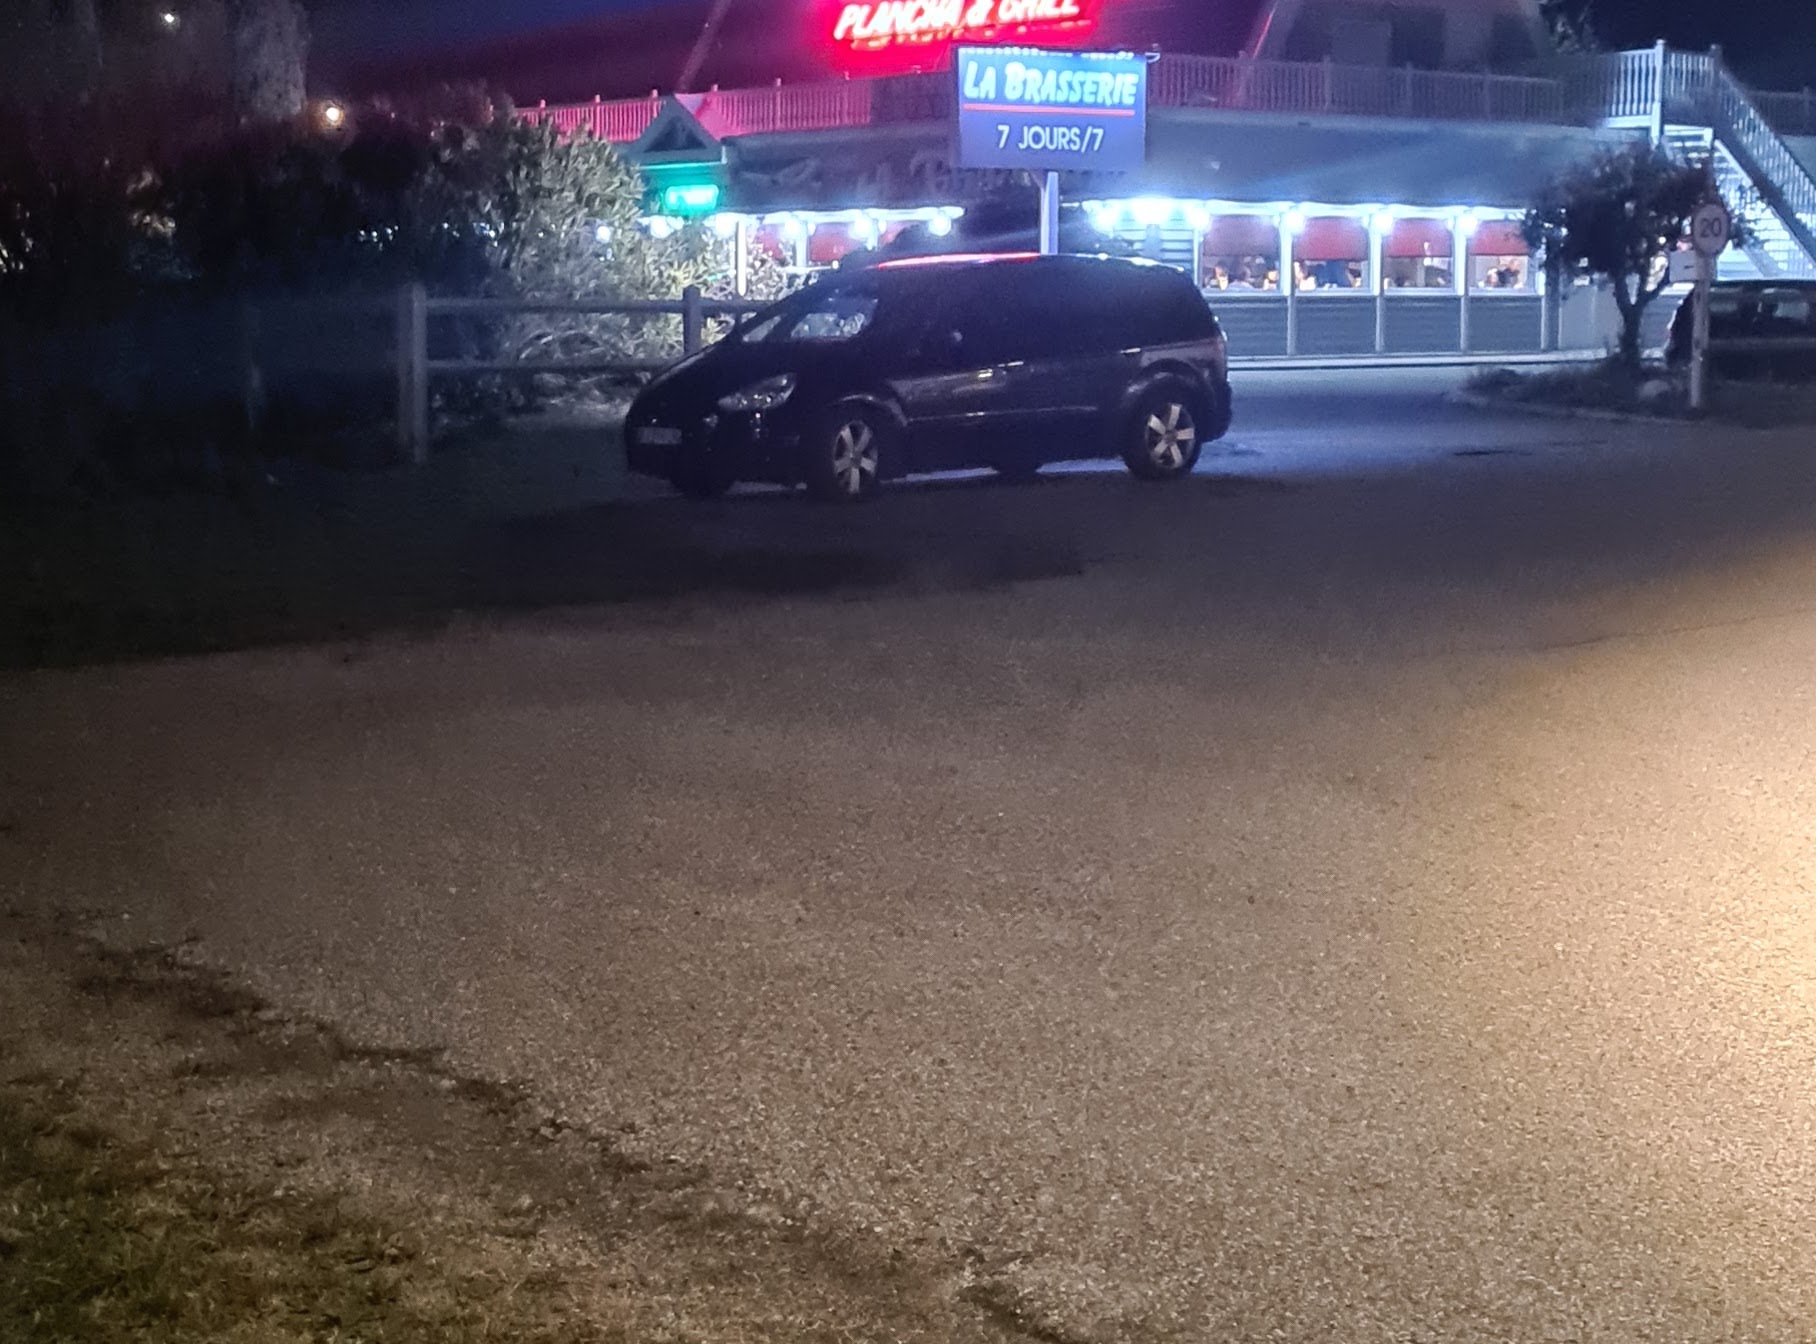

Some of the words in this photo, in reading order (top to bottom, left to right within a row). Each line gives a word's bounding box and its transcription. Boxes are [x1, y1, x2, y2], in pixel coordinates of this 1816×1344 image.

[963, 60, 997, 100] LA
[1004, 61, 1140, 106] BRASSERIE
[997, 124, 1011, 149] 7
[1018, 125, 1105, 153] JOURS/7
